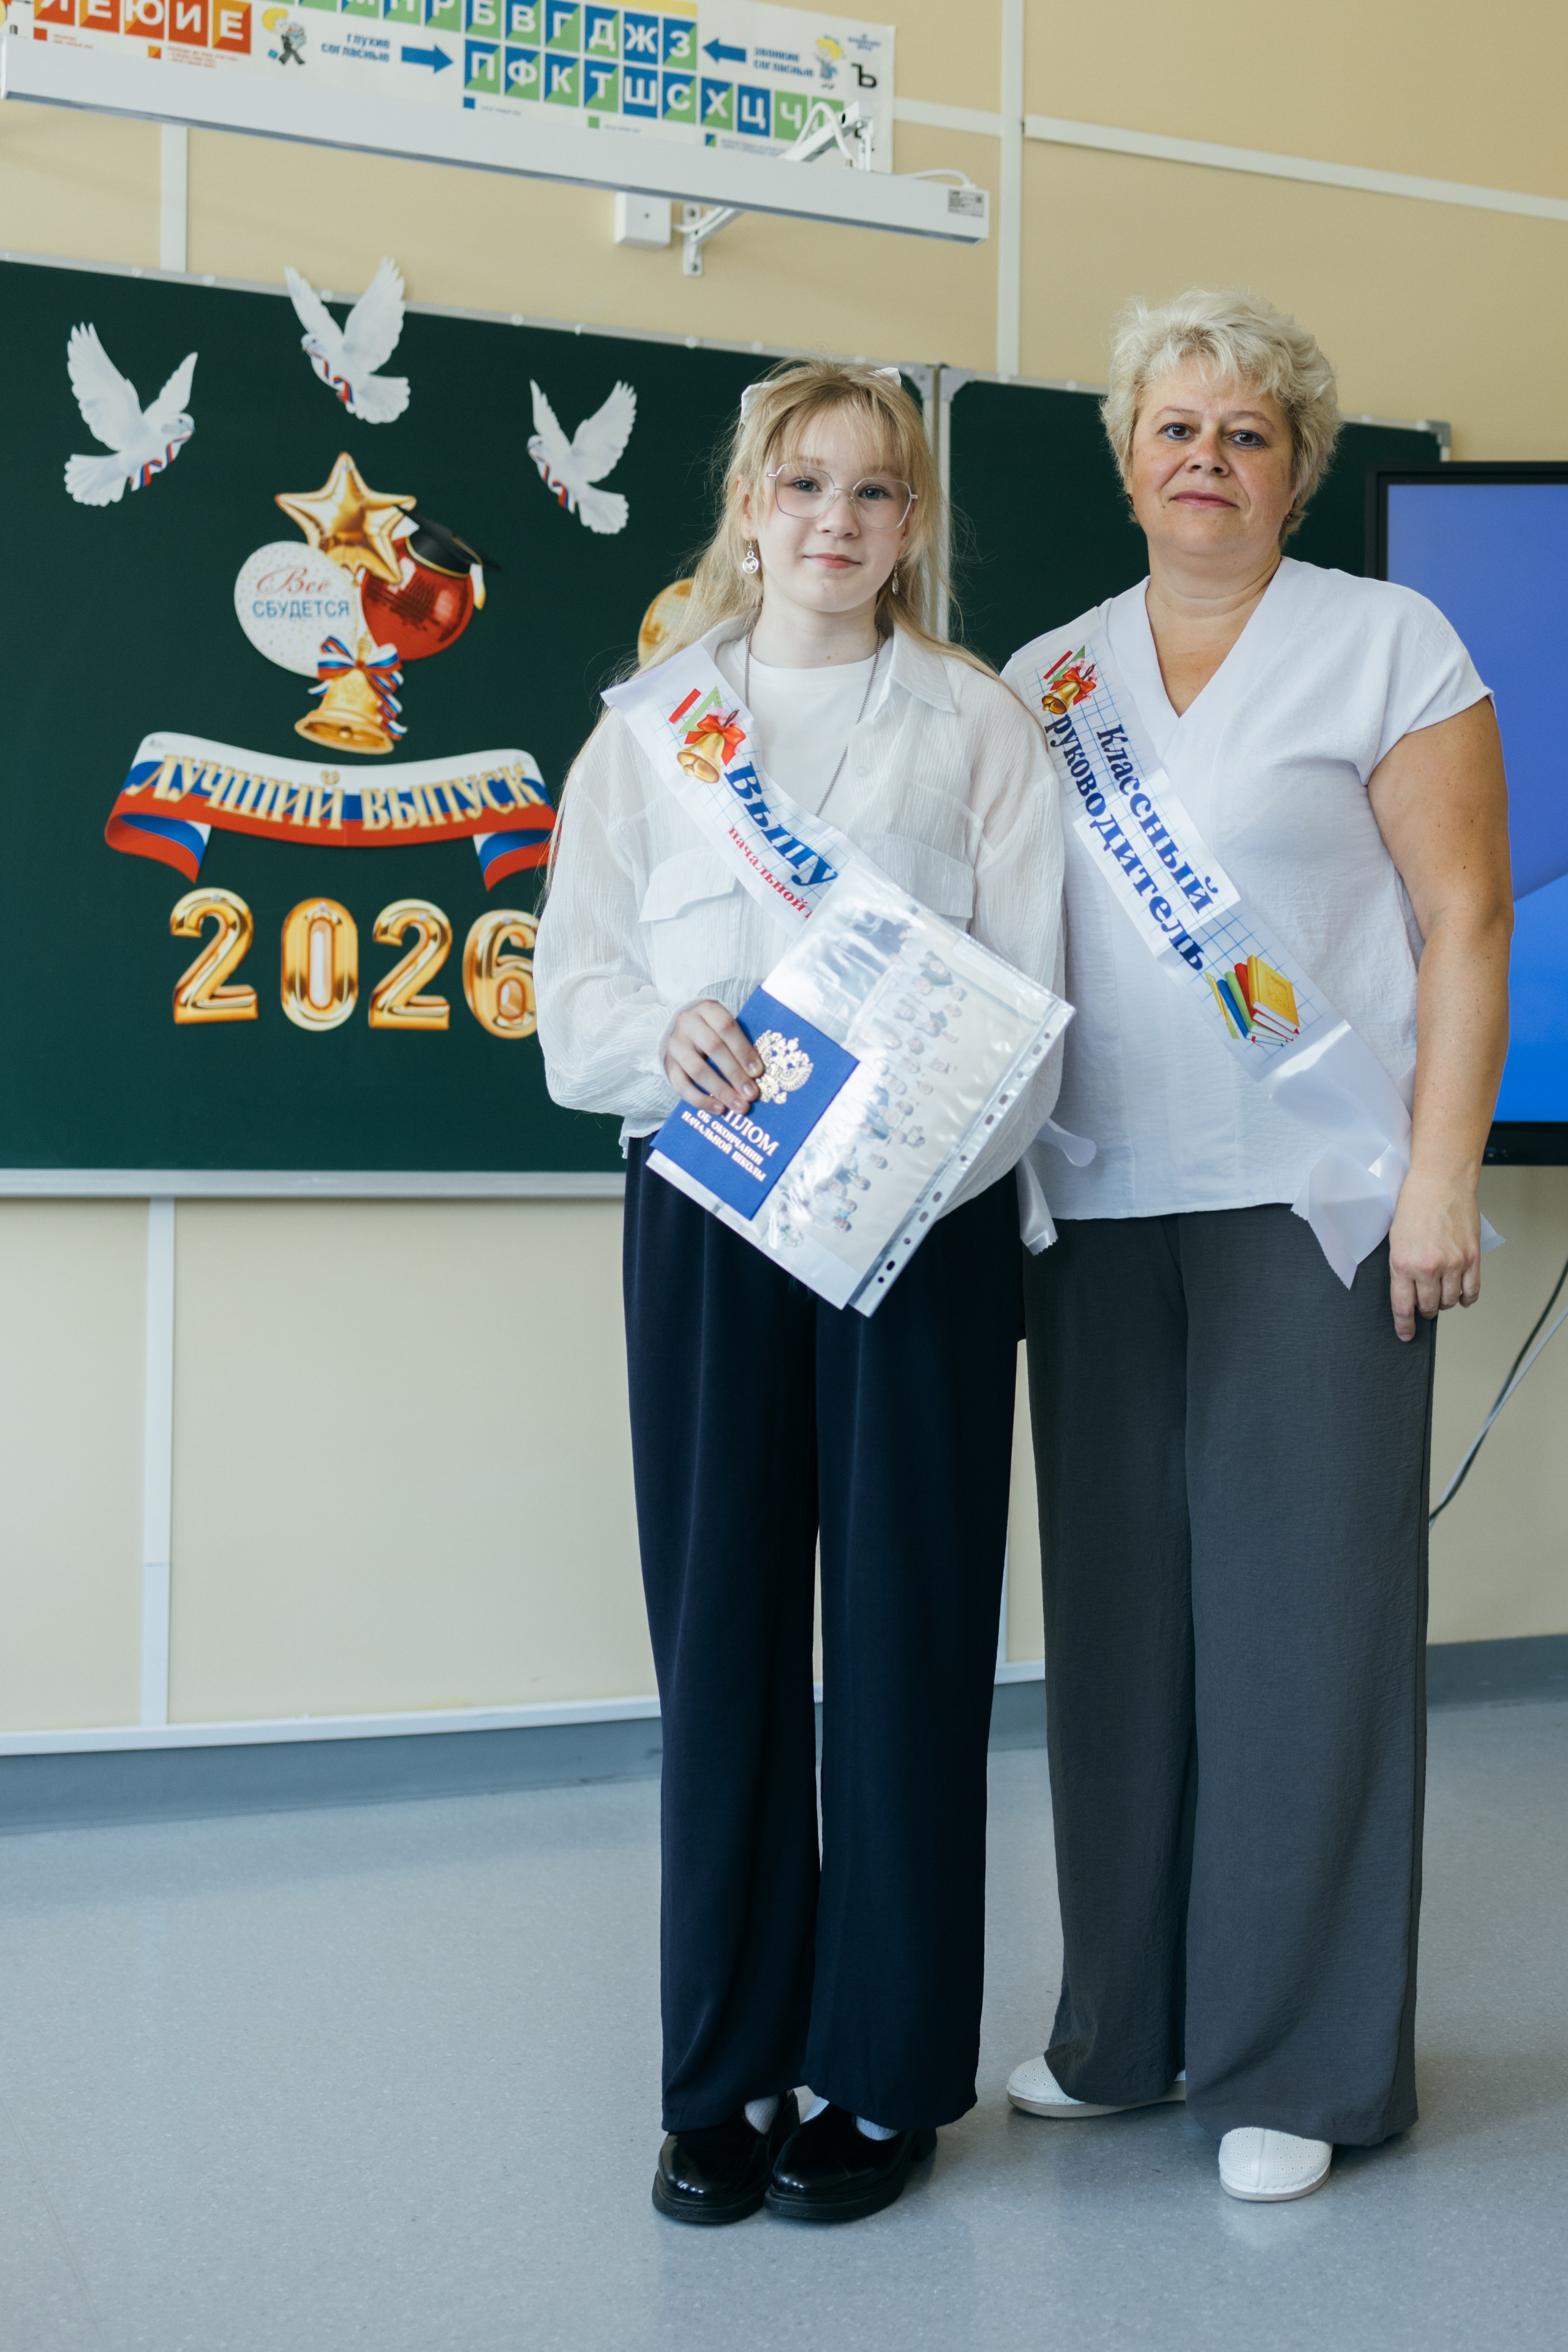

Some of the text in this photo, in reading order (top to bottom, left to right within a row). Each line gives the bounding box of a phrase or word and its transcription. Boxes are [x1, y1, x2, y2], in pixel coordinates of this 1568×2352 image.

[252, 600, 349, 619] СБУДЕТСЯ
[126, 754, 546, 831] ЛУЧШИЙ ВЫПУСК
[1096, 724, 1218, 914] Классный
[728, 827, 808, 912] начальной
[1044, 714, 1204, 970] руководитель
[170, 888, 540, 1039] 2026
[680, 1110, 767, 1183] НАЧАЛЬНОЙ ШКОЛЫ
[696, 1109, 764, 1166] ОБ ОКОНЧАНИИ
[720, 1110, 780, 1157] ПЛОМ
